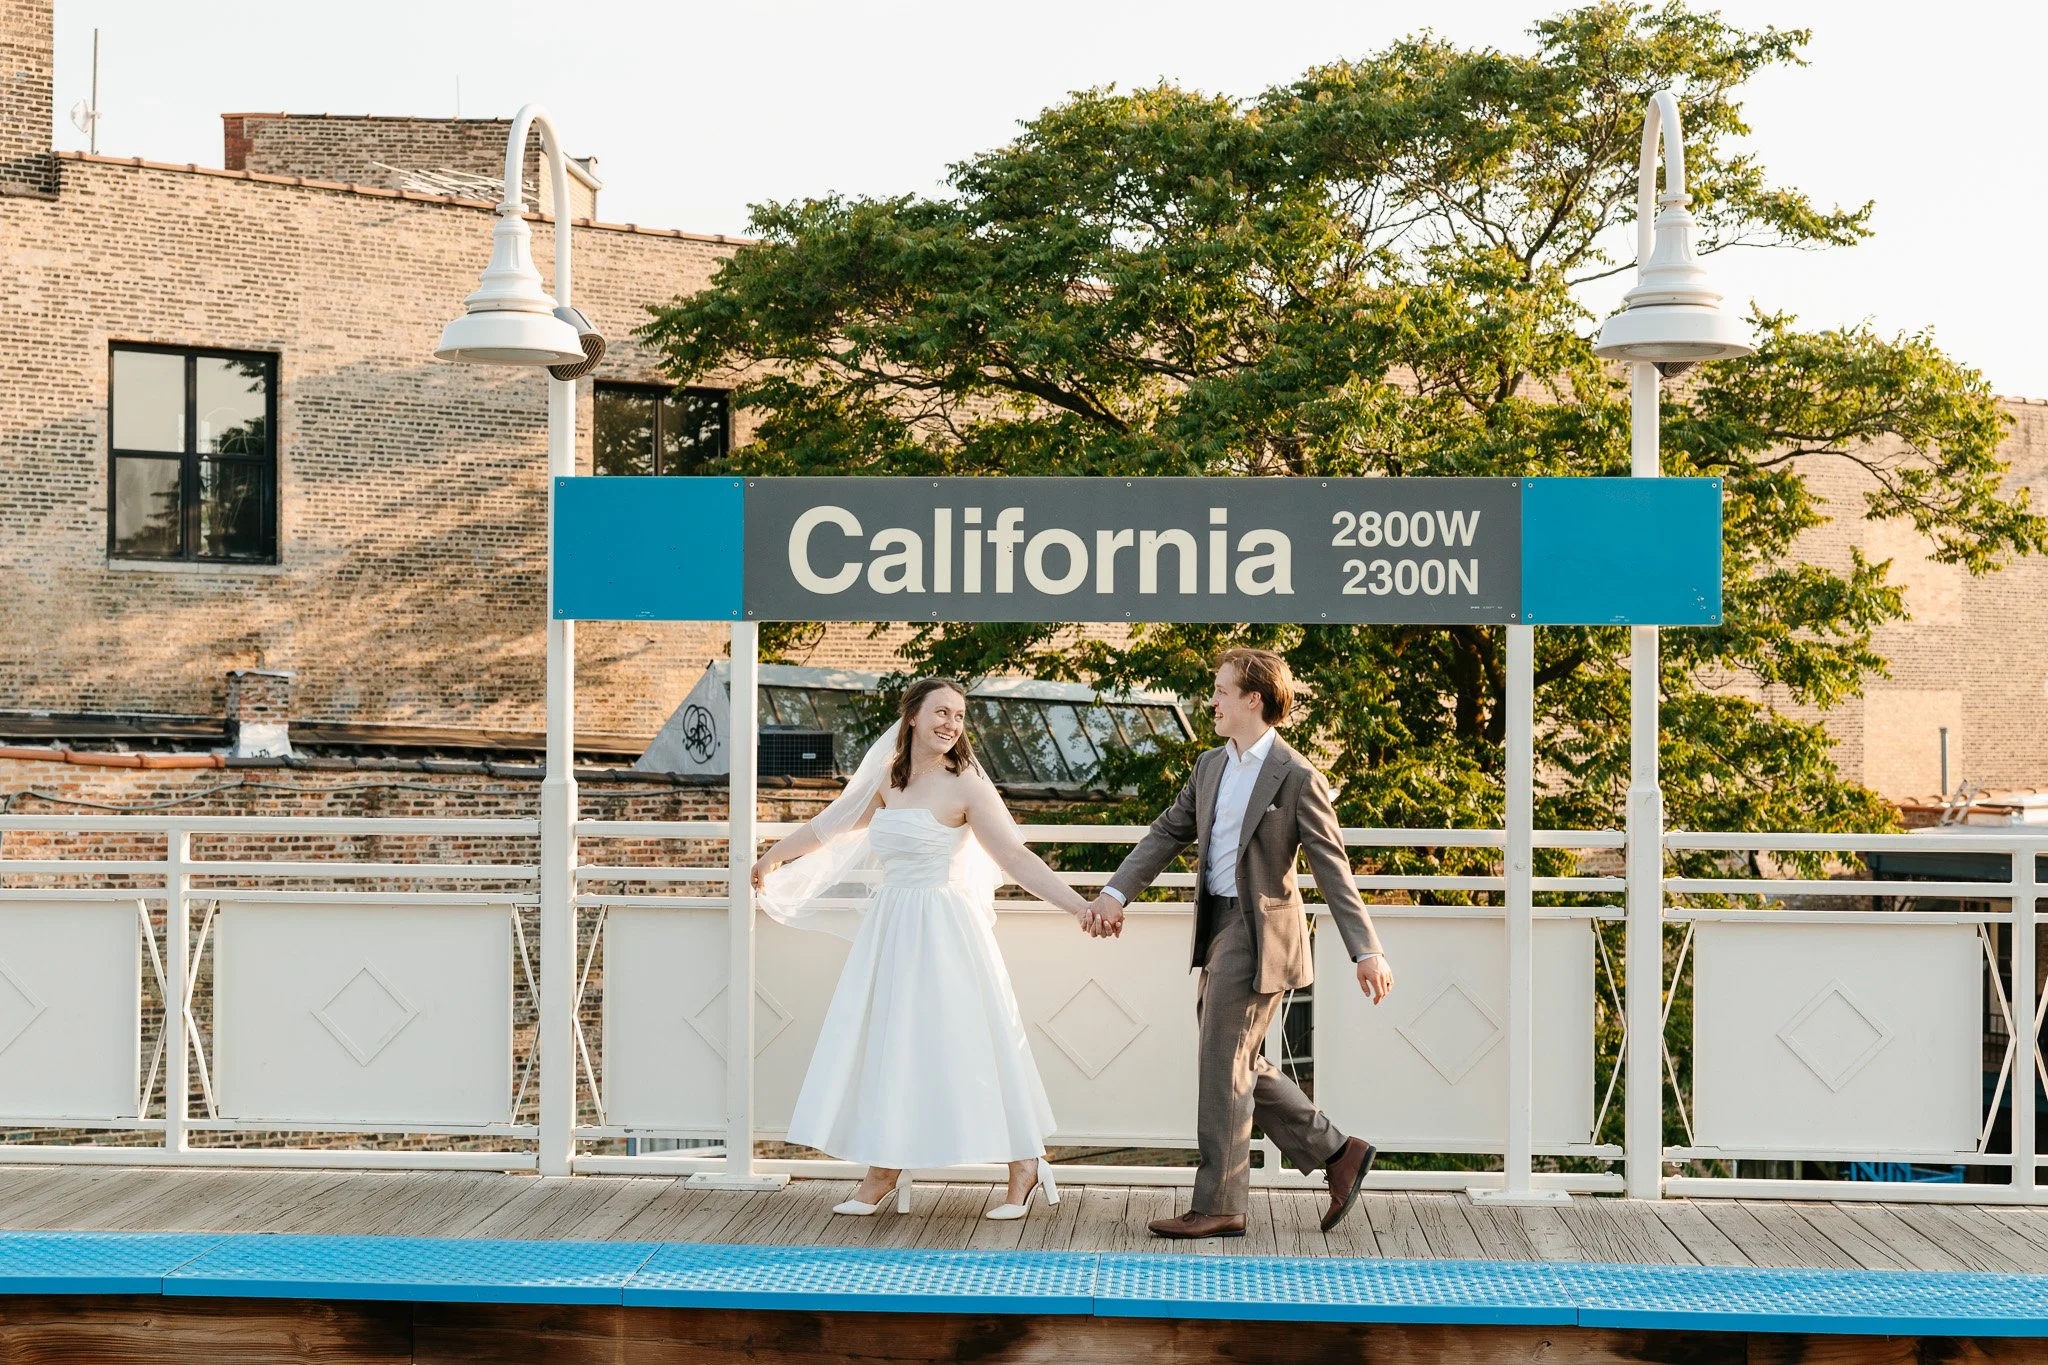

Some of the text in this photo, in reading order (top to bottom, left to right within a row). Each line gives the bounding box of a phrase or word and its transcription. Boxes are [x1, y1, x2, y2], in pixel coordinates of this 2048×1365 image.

[1331, 510, 1481, 548] 2800W
[788, 506, 1295, 596] California
[1341, 558, 1480, 596] 2300N
